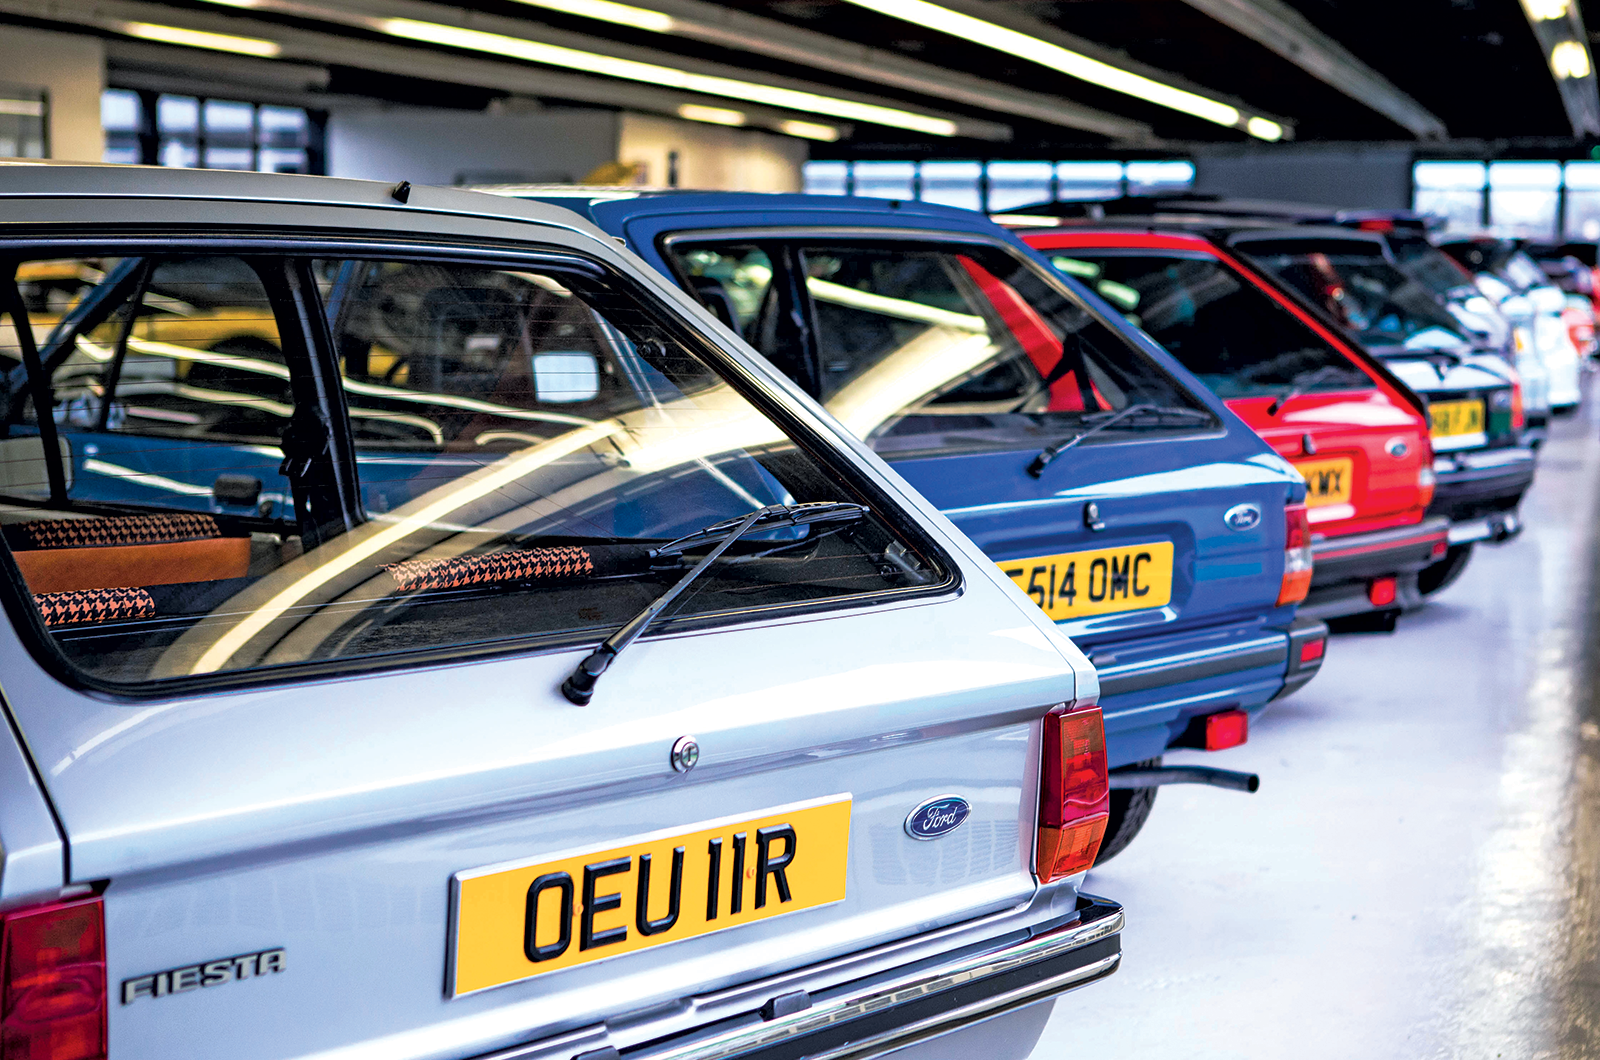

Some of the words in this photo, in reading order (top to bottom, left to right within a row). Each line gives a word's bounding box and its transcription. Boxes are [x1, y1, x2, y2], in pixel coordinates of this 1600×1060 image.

[1004, 560, 1077, 611] 514
[1088, 552, 1152, 602] OMC
[922, 803, 958, 831] Ford
[524, 845, 686, 963] OEU
[705, 822, 797, 922] 11R
[121, 947, 287, 1006] FIESTA
